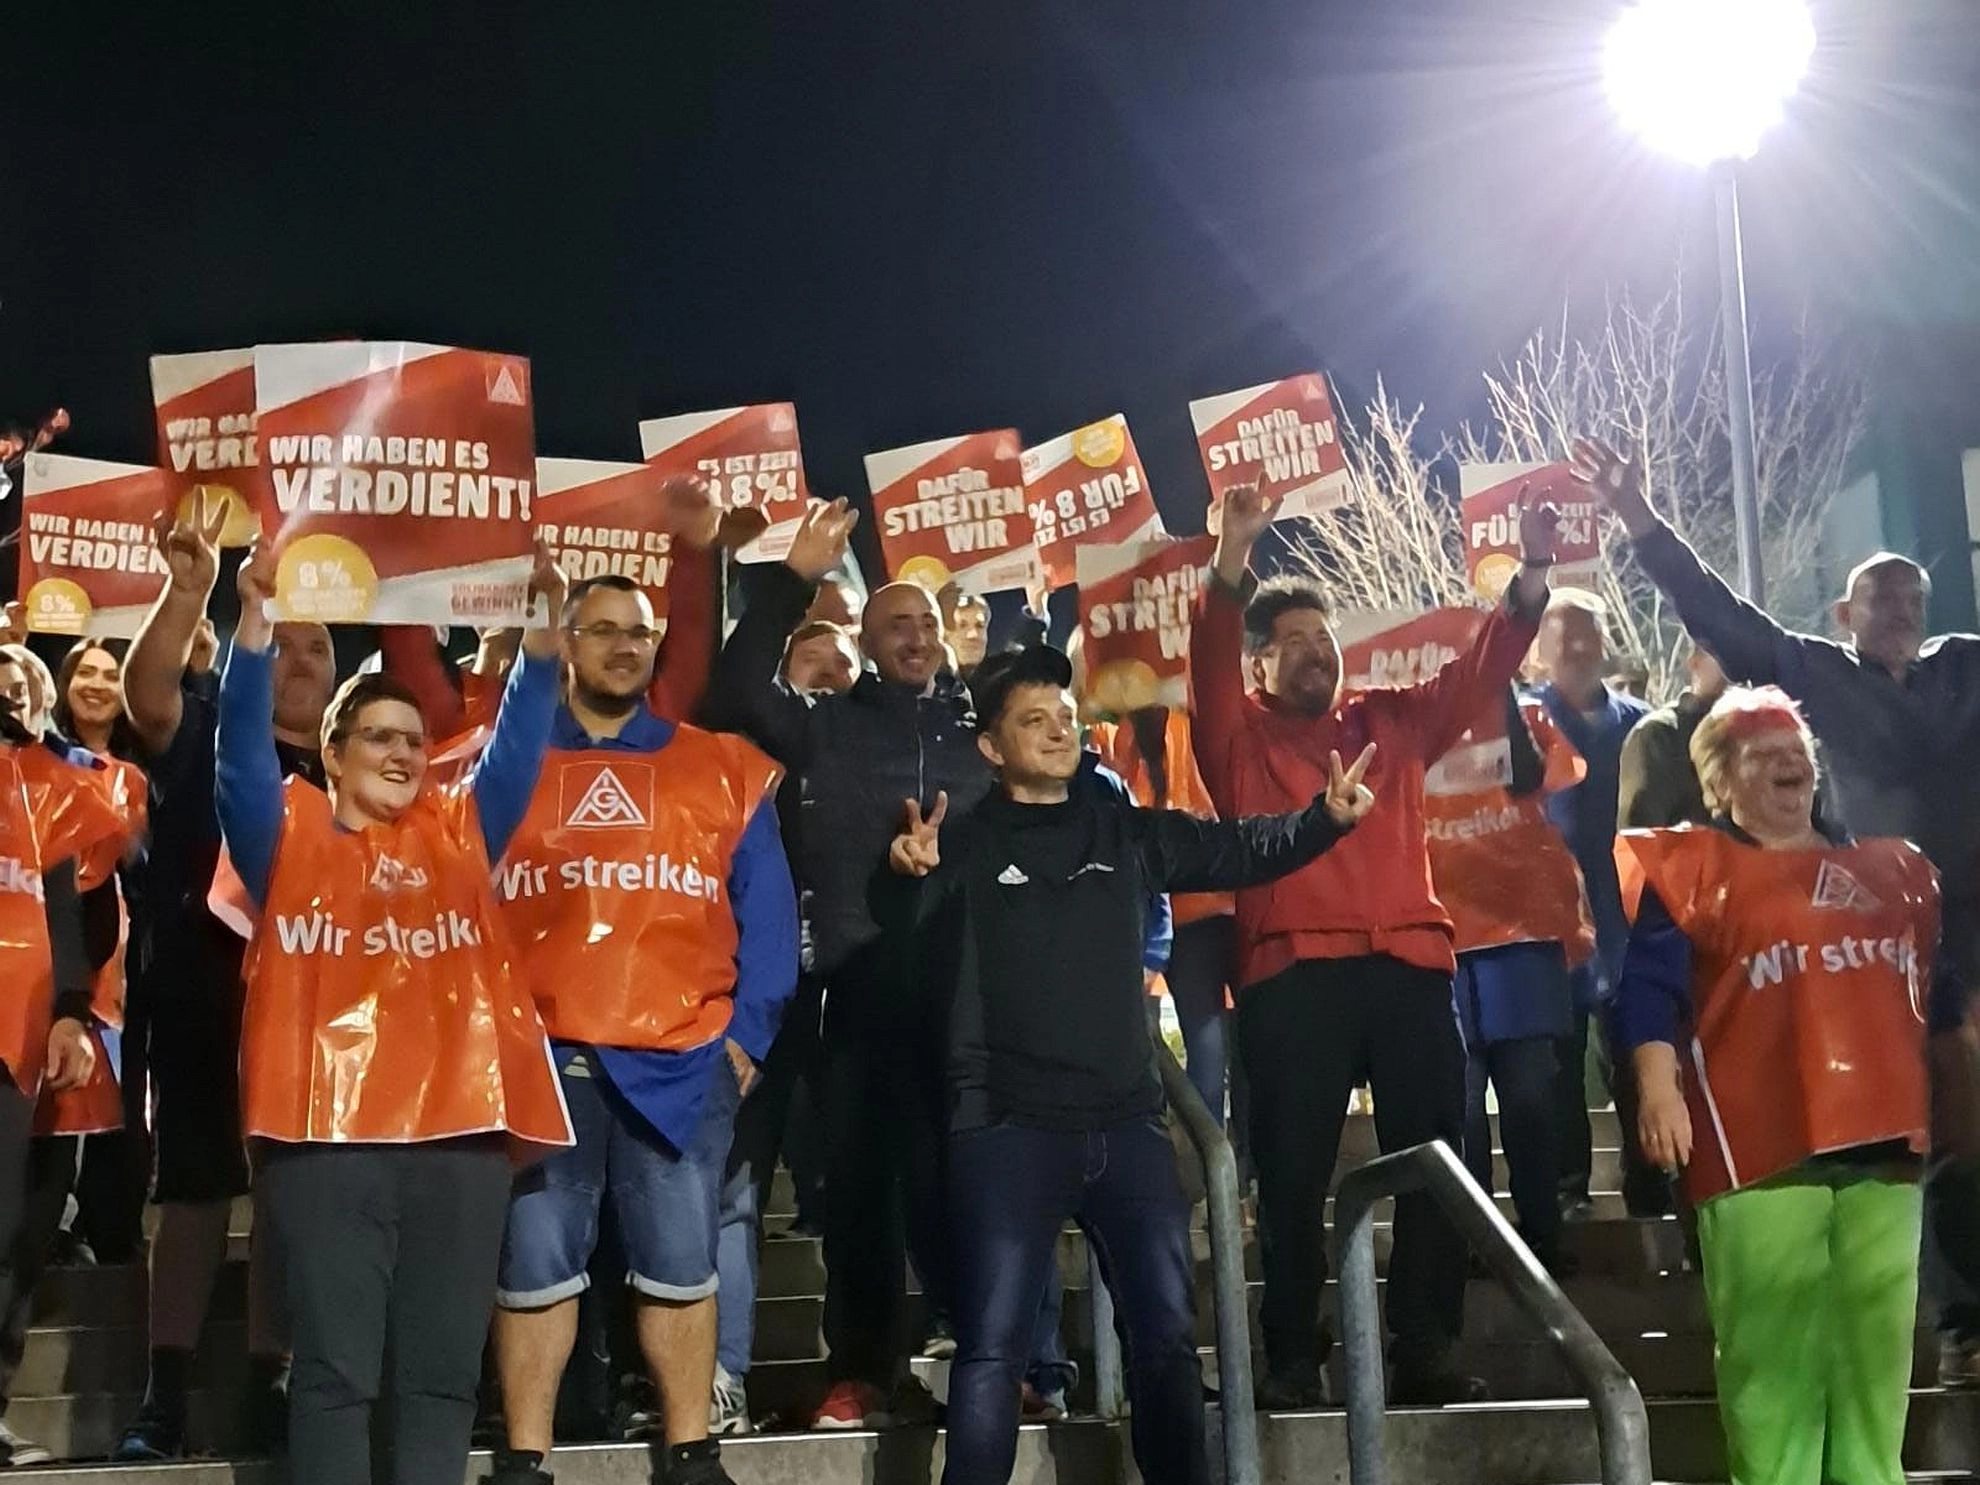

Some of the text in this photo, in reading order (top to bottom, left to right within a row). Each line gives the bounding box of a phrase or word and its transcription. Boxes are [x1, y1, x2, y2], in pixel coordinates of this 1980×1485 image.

[1237, 408, 1300, 439] DAFÜR
[270, 434, 490, 470] WIR HABEN ES
[1208, 420, 1334, 471] STREITEN
[917, 467, 989, 500] DAFÜR
[1265, 450, 1321, 483] WIR
[272, 467, 532, 522] VERDIENT!
[1080, 465, 1140, 509] FÜR
[29, 512, 70, 535] WIR
[74, 518, 144, 543] HABEN
[884, 486, 1025, 536] STREITEN
[564, 525, 638, 549] HABEN
[945, 518, 1009, 553] WIR
[559, 853, 719, 904] streiken
[276, 909, 481, 959] Wir streik
